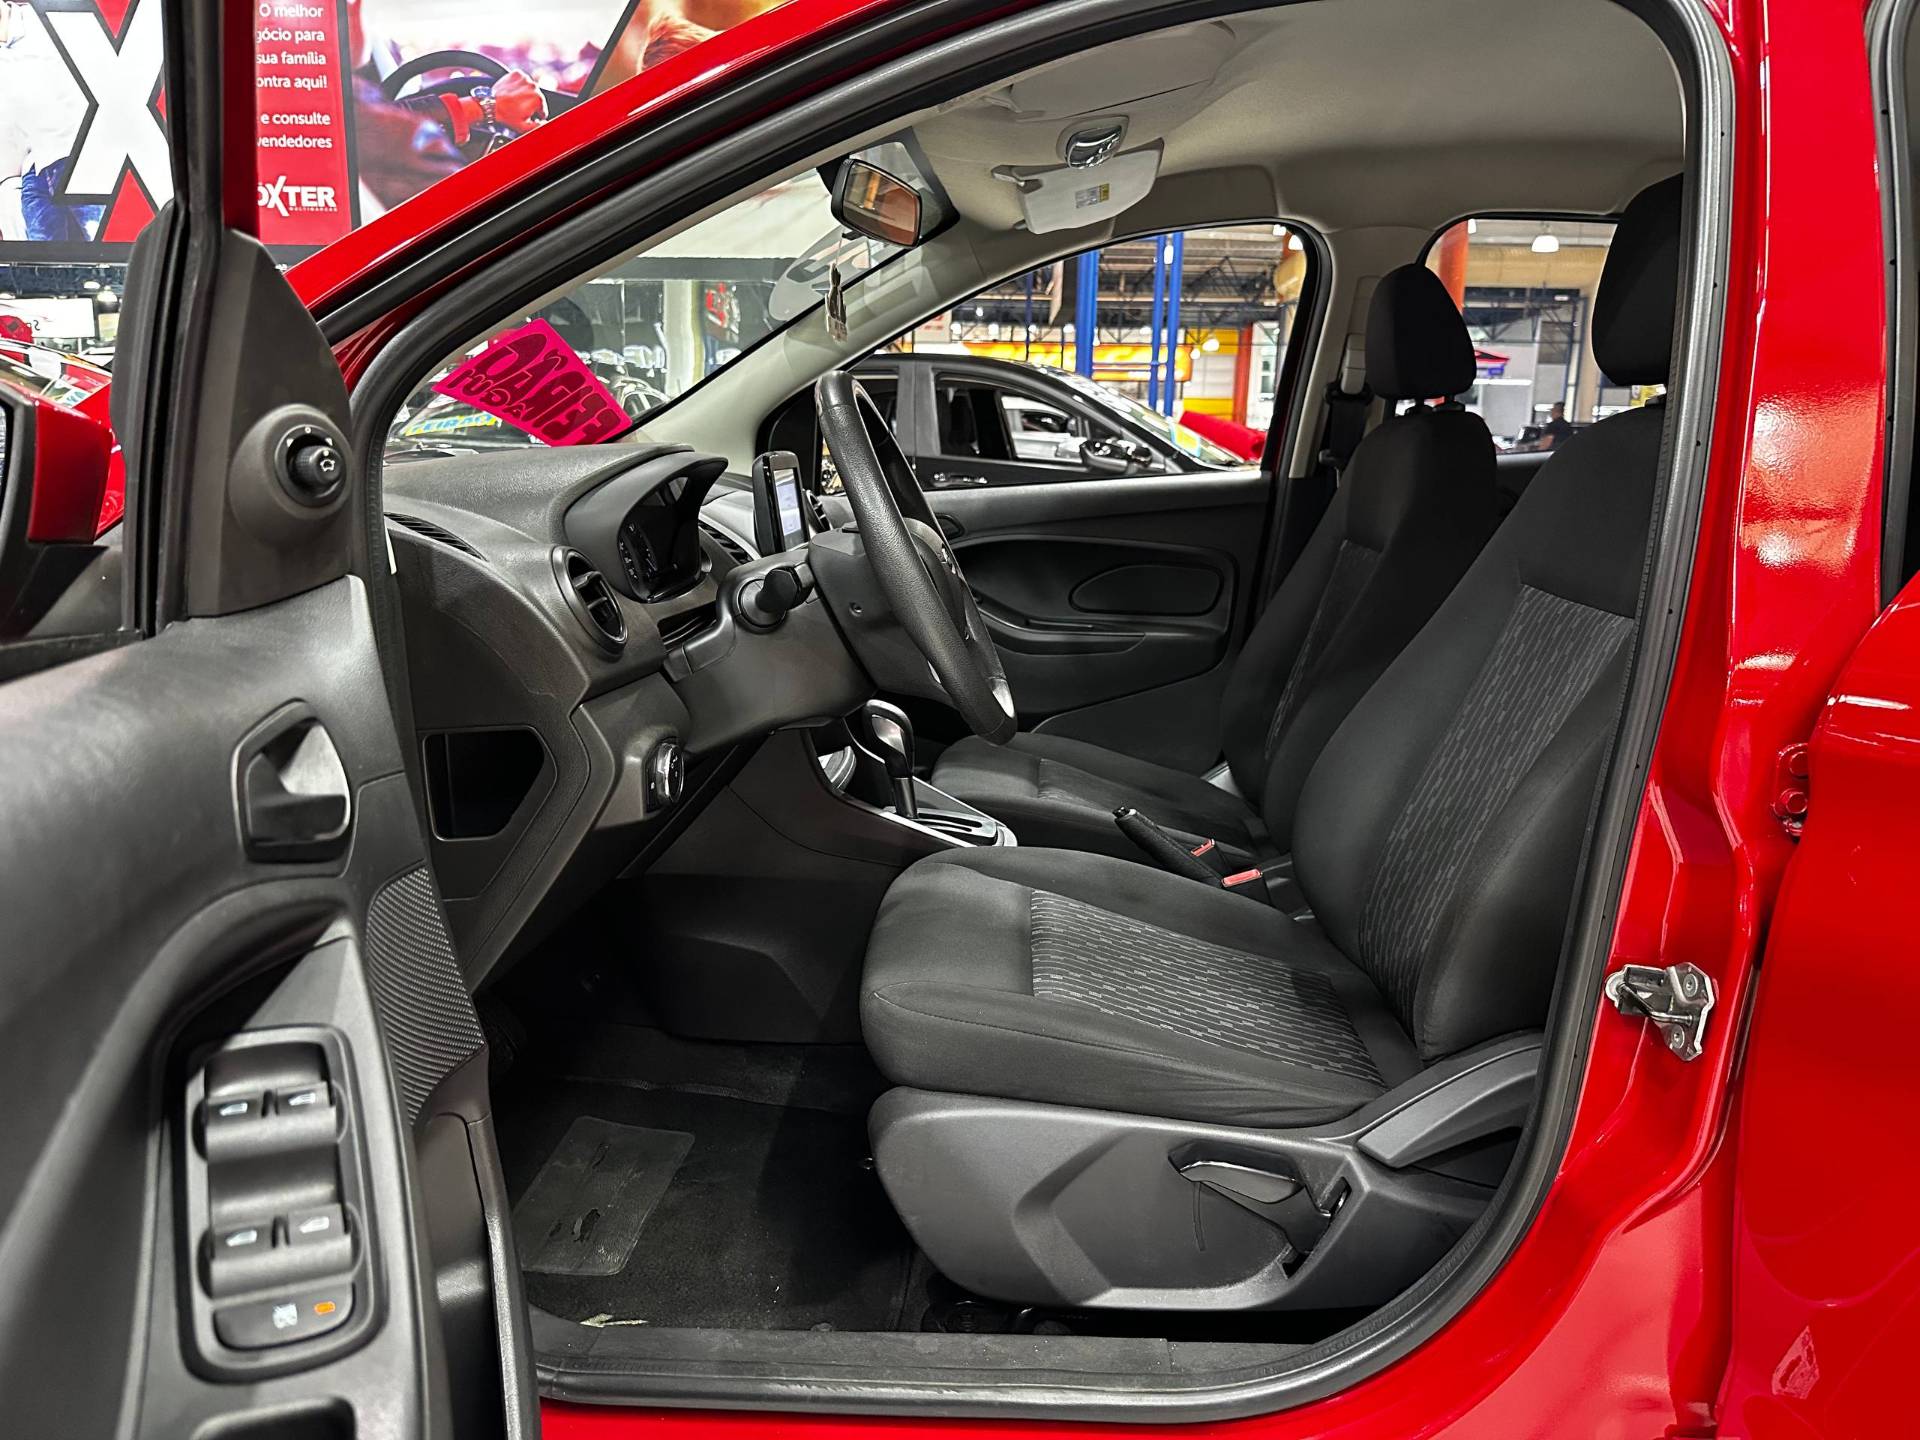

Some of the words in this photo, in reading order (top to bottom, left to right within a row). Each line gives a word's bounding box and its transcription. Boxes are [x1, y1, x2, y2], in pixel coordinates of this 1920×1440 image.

[259, 3, 271, 17] O
[274, 3, 324, 17] melhor
[295, 30, 325, 44] para
[256, 54, 278, 65] sua
[281, 51, 327, 65] família
[294, 75, 328, 91] aqui!
[260, 113, 269, 125] e
[272, 111, 331, 126] consulte
